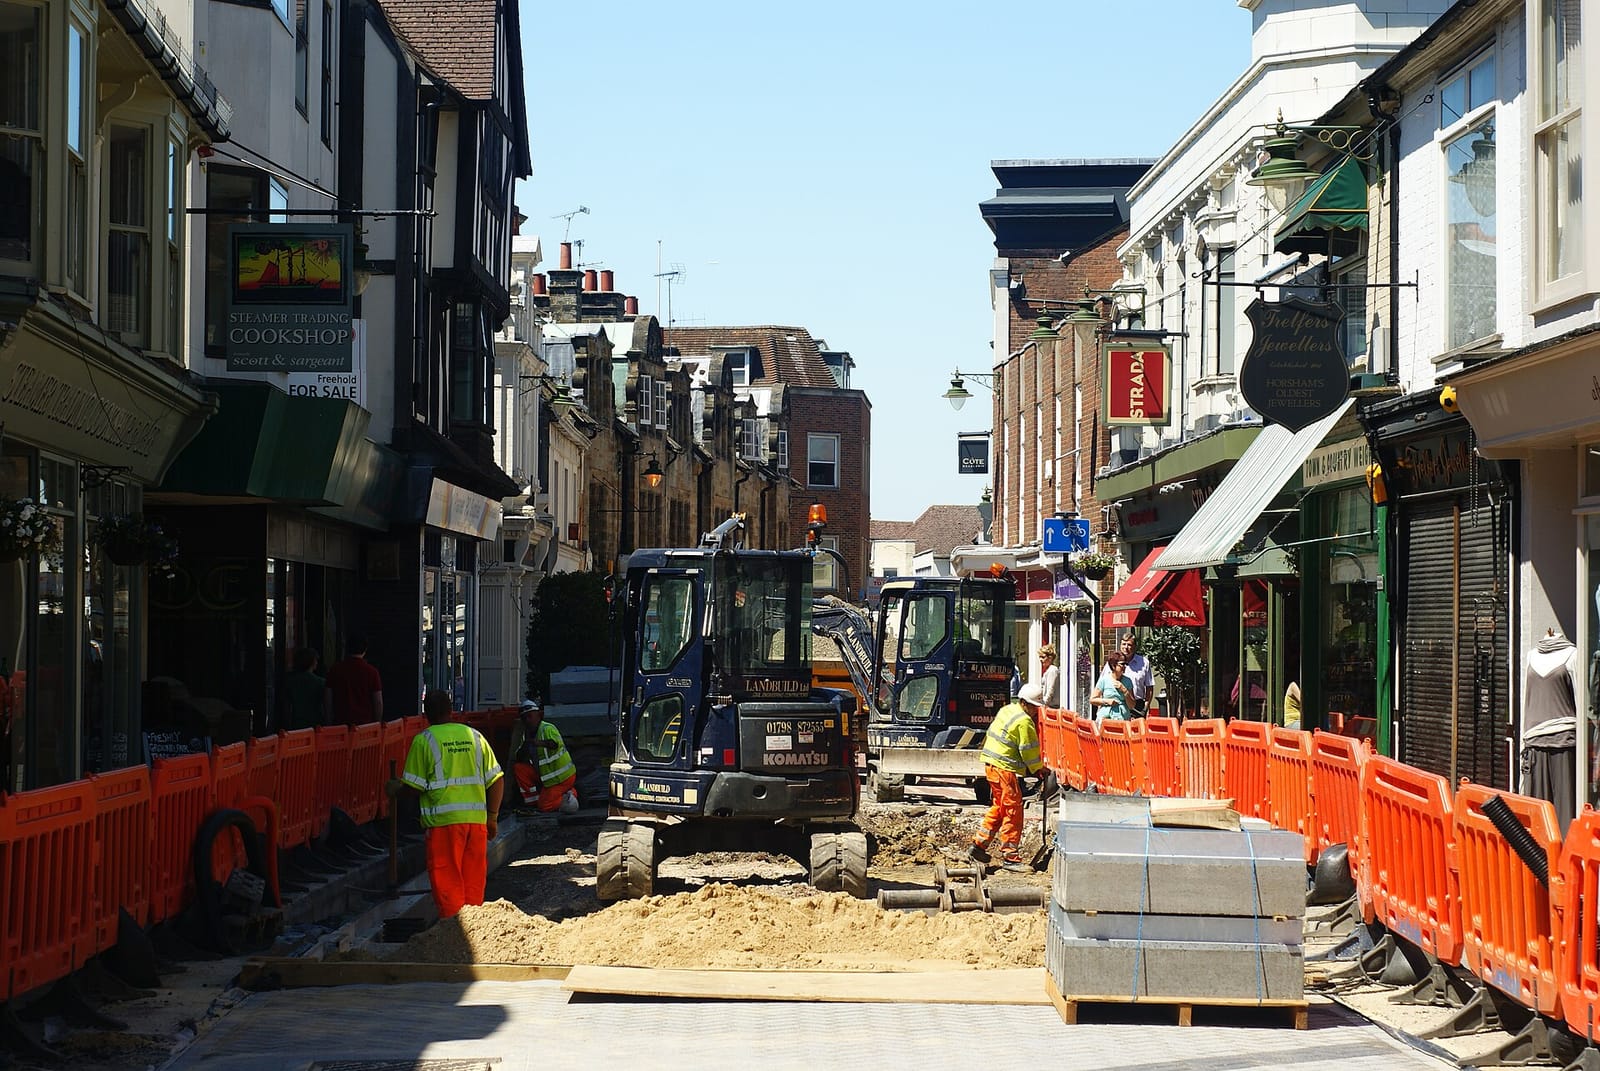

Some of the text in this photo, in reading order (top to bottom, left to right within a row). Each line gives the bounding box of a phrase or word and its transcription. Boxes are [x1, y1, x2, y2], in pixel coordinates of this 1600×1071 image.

[230, 312, 349, 324] STEAMER TRADING
[1262, 308, 1329, 335] Trelfers
[230, 328, 349, 345] COOKSHOP
[1255, 335, 1332, 357] Jewellers
[232, 353, 344, 368] scott & sargeant
[317, 374, 357, 384] Freehold
[1130, 351, 1144, 418] STRADA
[289, 384, 357, 398] FOR SALE
[1275, 389, 1314, 399] OLDEST
[1267, 399, 1322, 409] JEWELLERS
[745, 679, 799, 692] LANDBUILD
[766, 721, 824, 733] 01798 872555
[763, 752, 829, 766] KOMATSU
